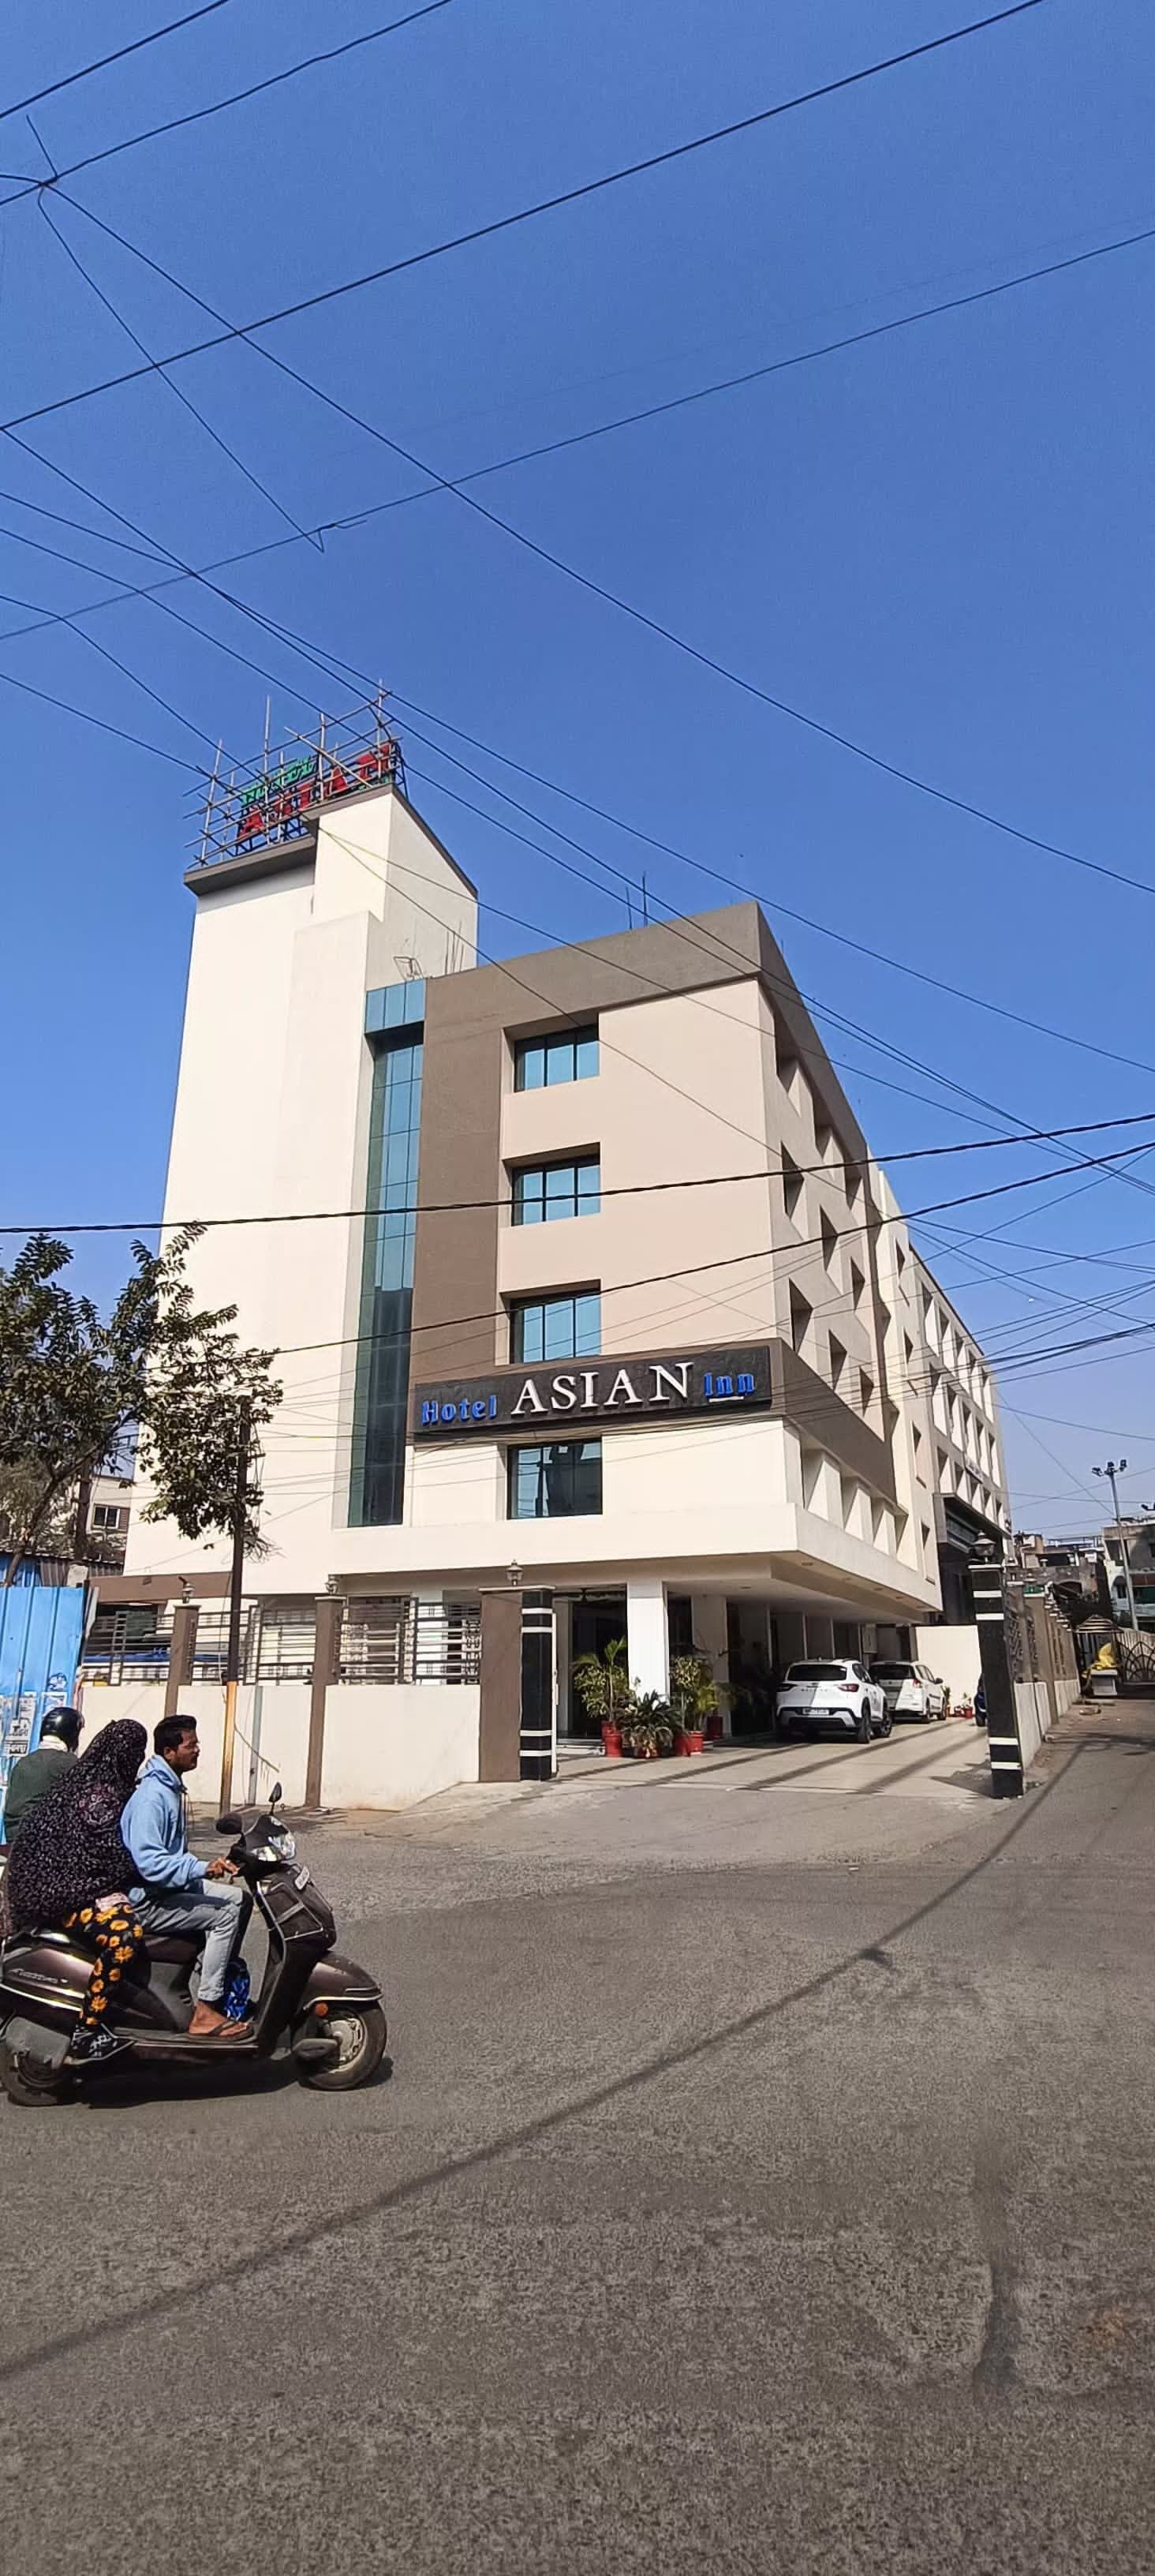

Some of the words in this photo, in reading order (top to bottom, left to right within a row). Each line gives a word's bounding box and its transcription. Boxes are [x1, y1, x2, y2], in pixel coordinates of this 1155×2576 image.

[422, 1395, 497, 1426] Hotel
[510, 1361, 694, 1416] ASIAN
[703, 1372, 755, 1398] Inn
